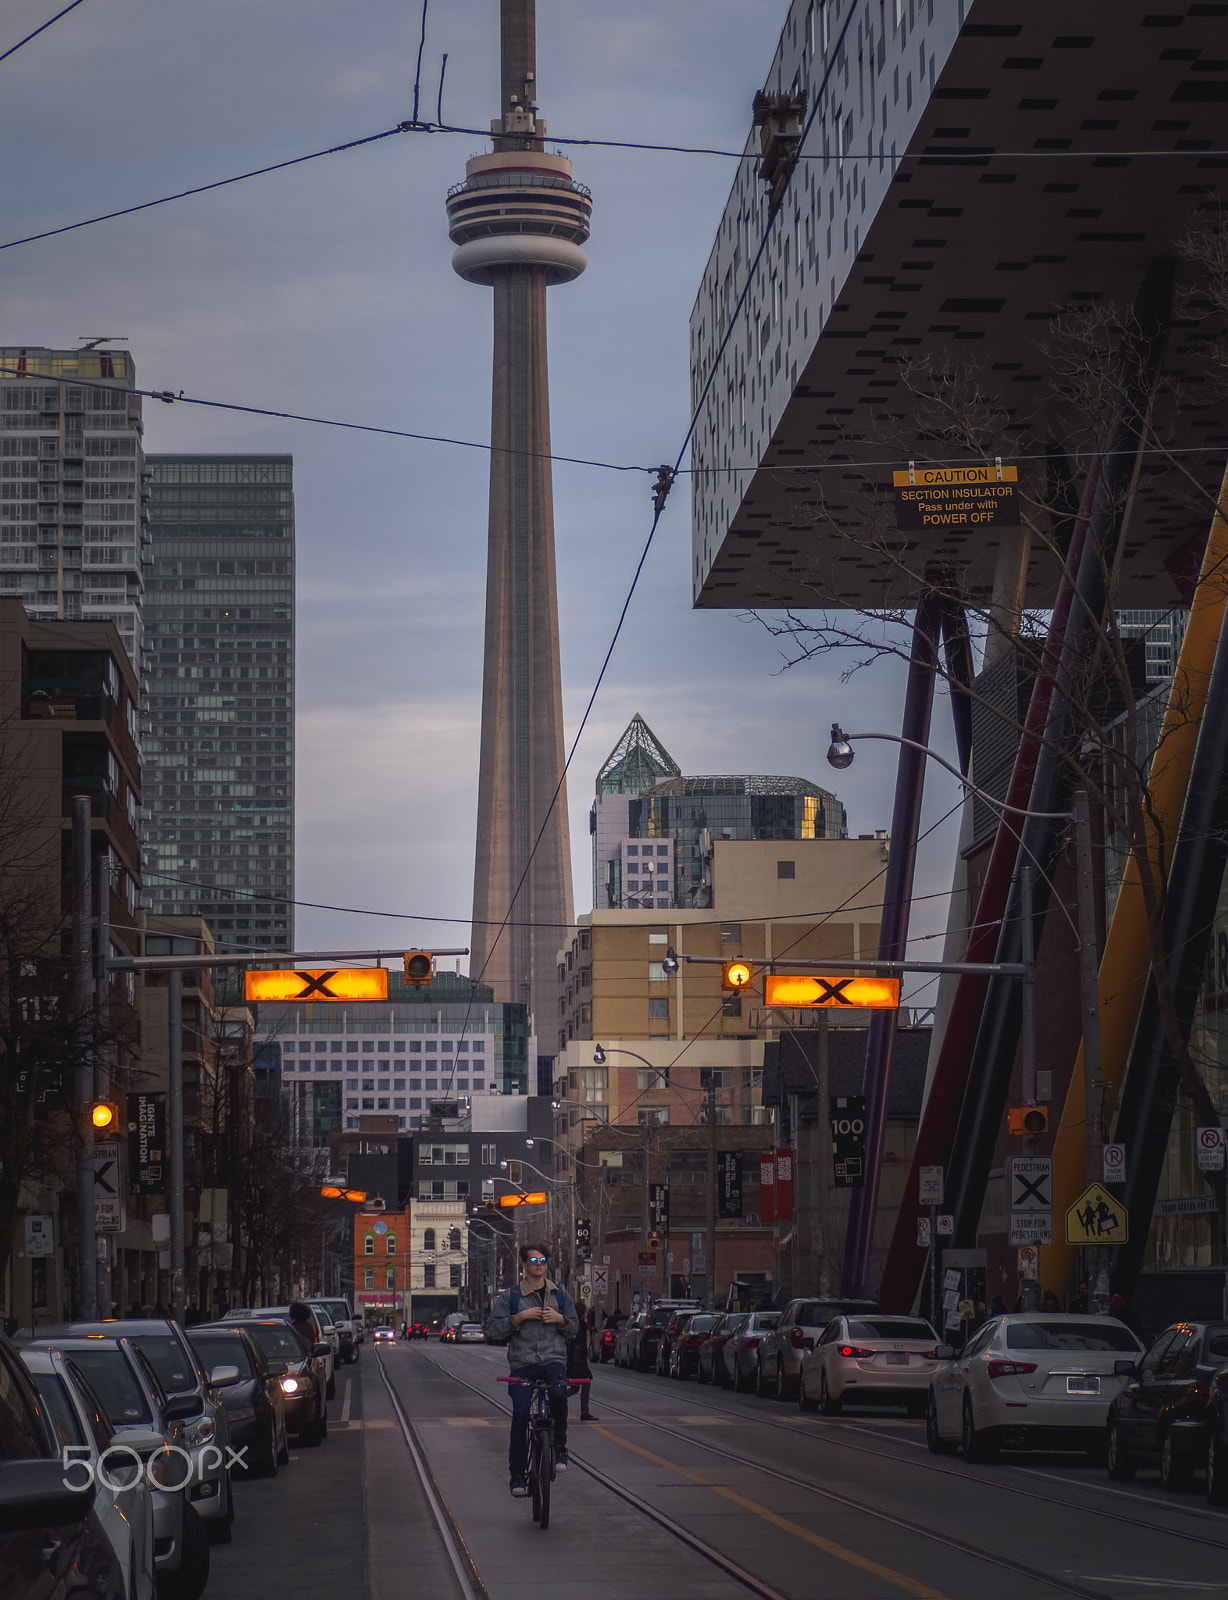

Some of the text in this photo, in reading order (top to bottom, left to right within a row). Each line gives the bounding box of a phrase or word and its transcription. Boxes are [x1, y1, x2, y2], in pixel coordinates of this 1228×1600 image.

[924, 469, 988, 483] CAUTION
[901, 486, 1013, 500] SECTION INSULATOR
[918, 499, 998, 512] Pass under with
[923, 511, 995, 525] POWER OFF
[147, 1103, 156, 1138] IGNITE
[831, 1118, 865, 1135] 100
[138, 1096, 149, 1164] IMAGINATION
[1013, 1163, 1050, 1173] PEDESTRIAN
[1016, 1219, 1047, 1229] STOP FOR
[577, 1229, 589, 1237] 60
[1012, 1230, 1052, 1240] PEDESTRIANS
